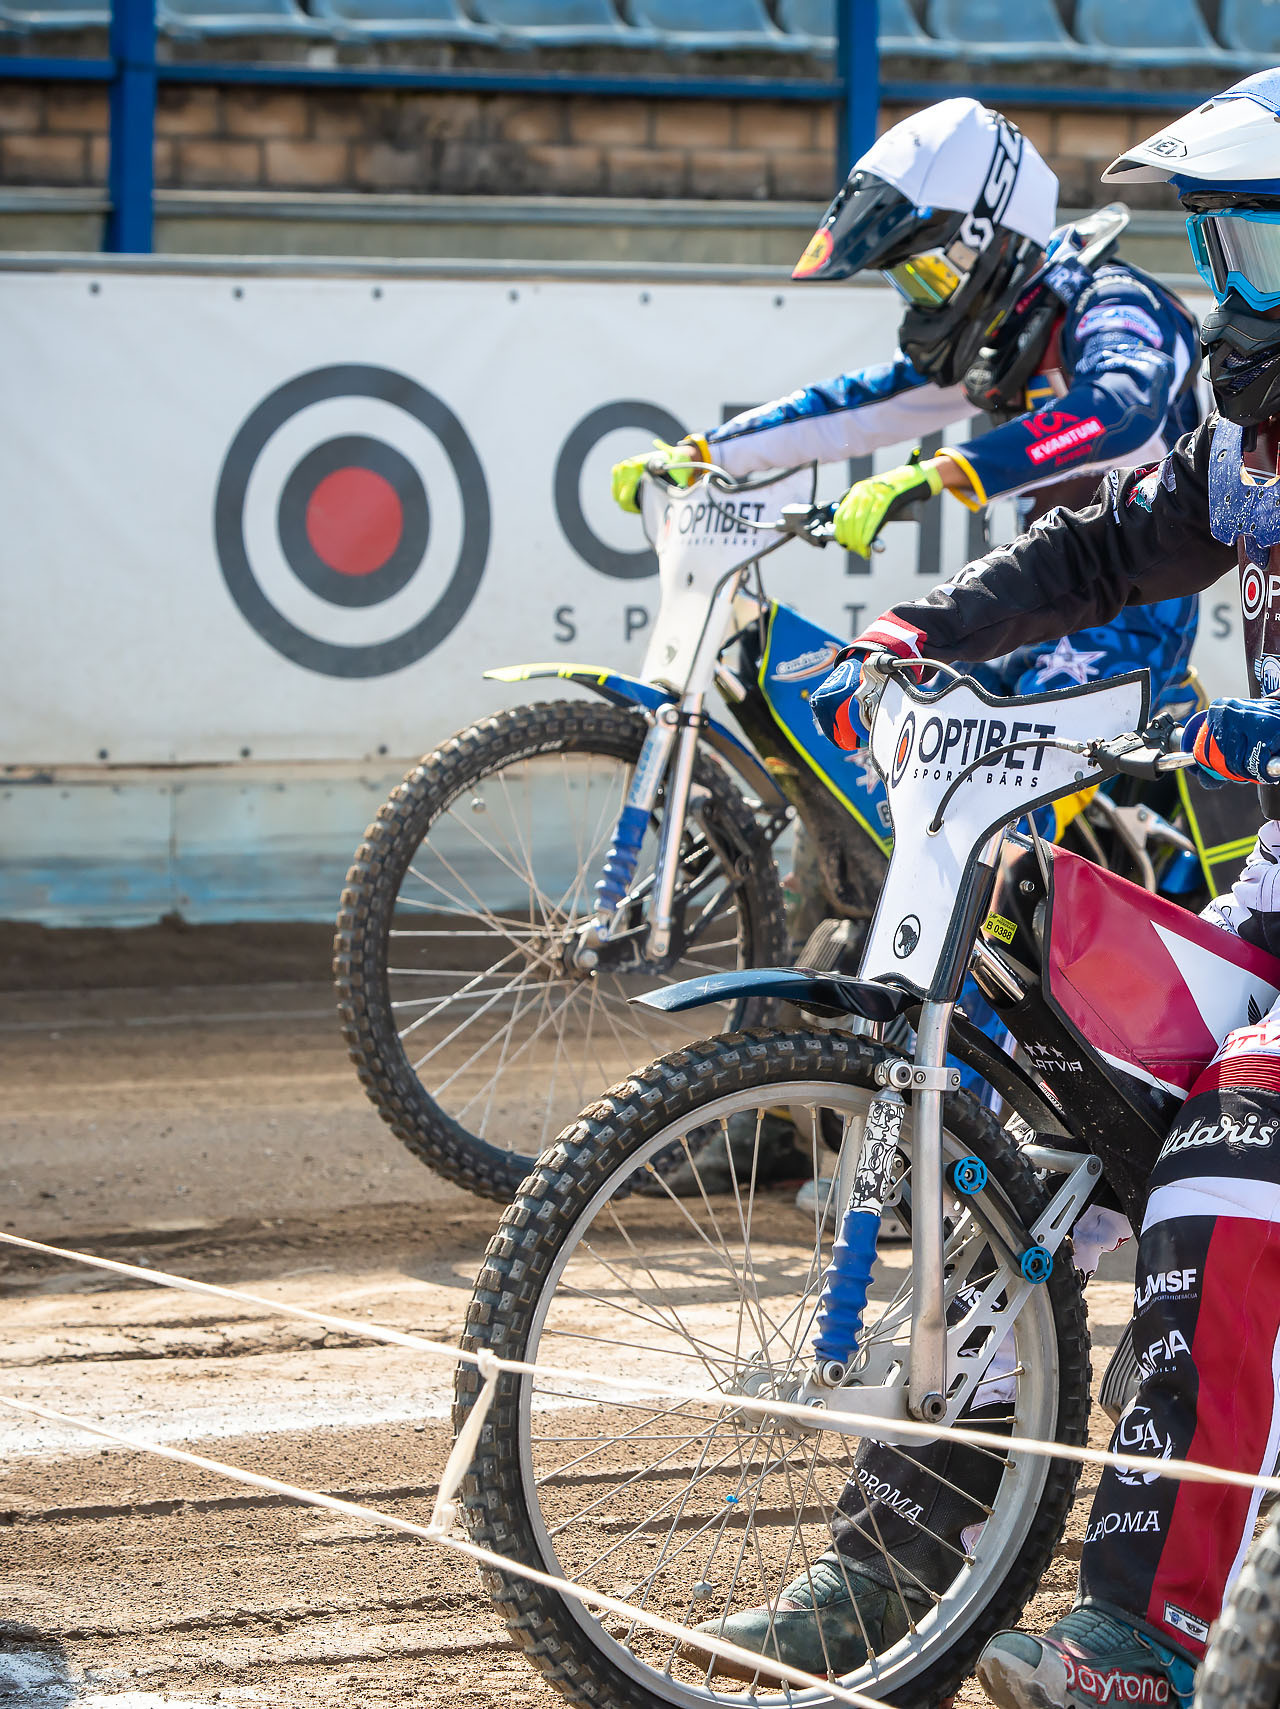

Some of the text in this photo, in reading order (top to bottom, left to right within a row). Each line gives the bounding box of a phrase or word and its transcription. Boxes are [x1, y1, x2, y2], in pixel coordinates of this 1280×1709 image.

[1030, 420, 1101, 460] KVANTUM
[679, 502, 765, 535] OPTIBET
[918, 716, 1056, 771] OPTIBET
[994, 924, 1012, 941] 0388
[1033, 1059, 1083, 1073] LATVIA
